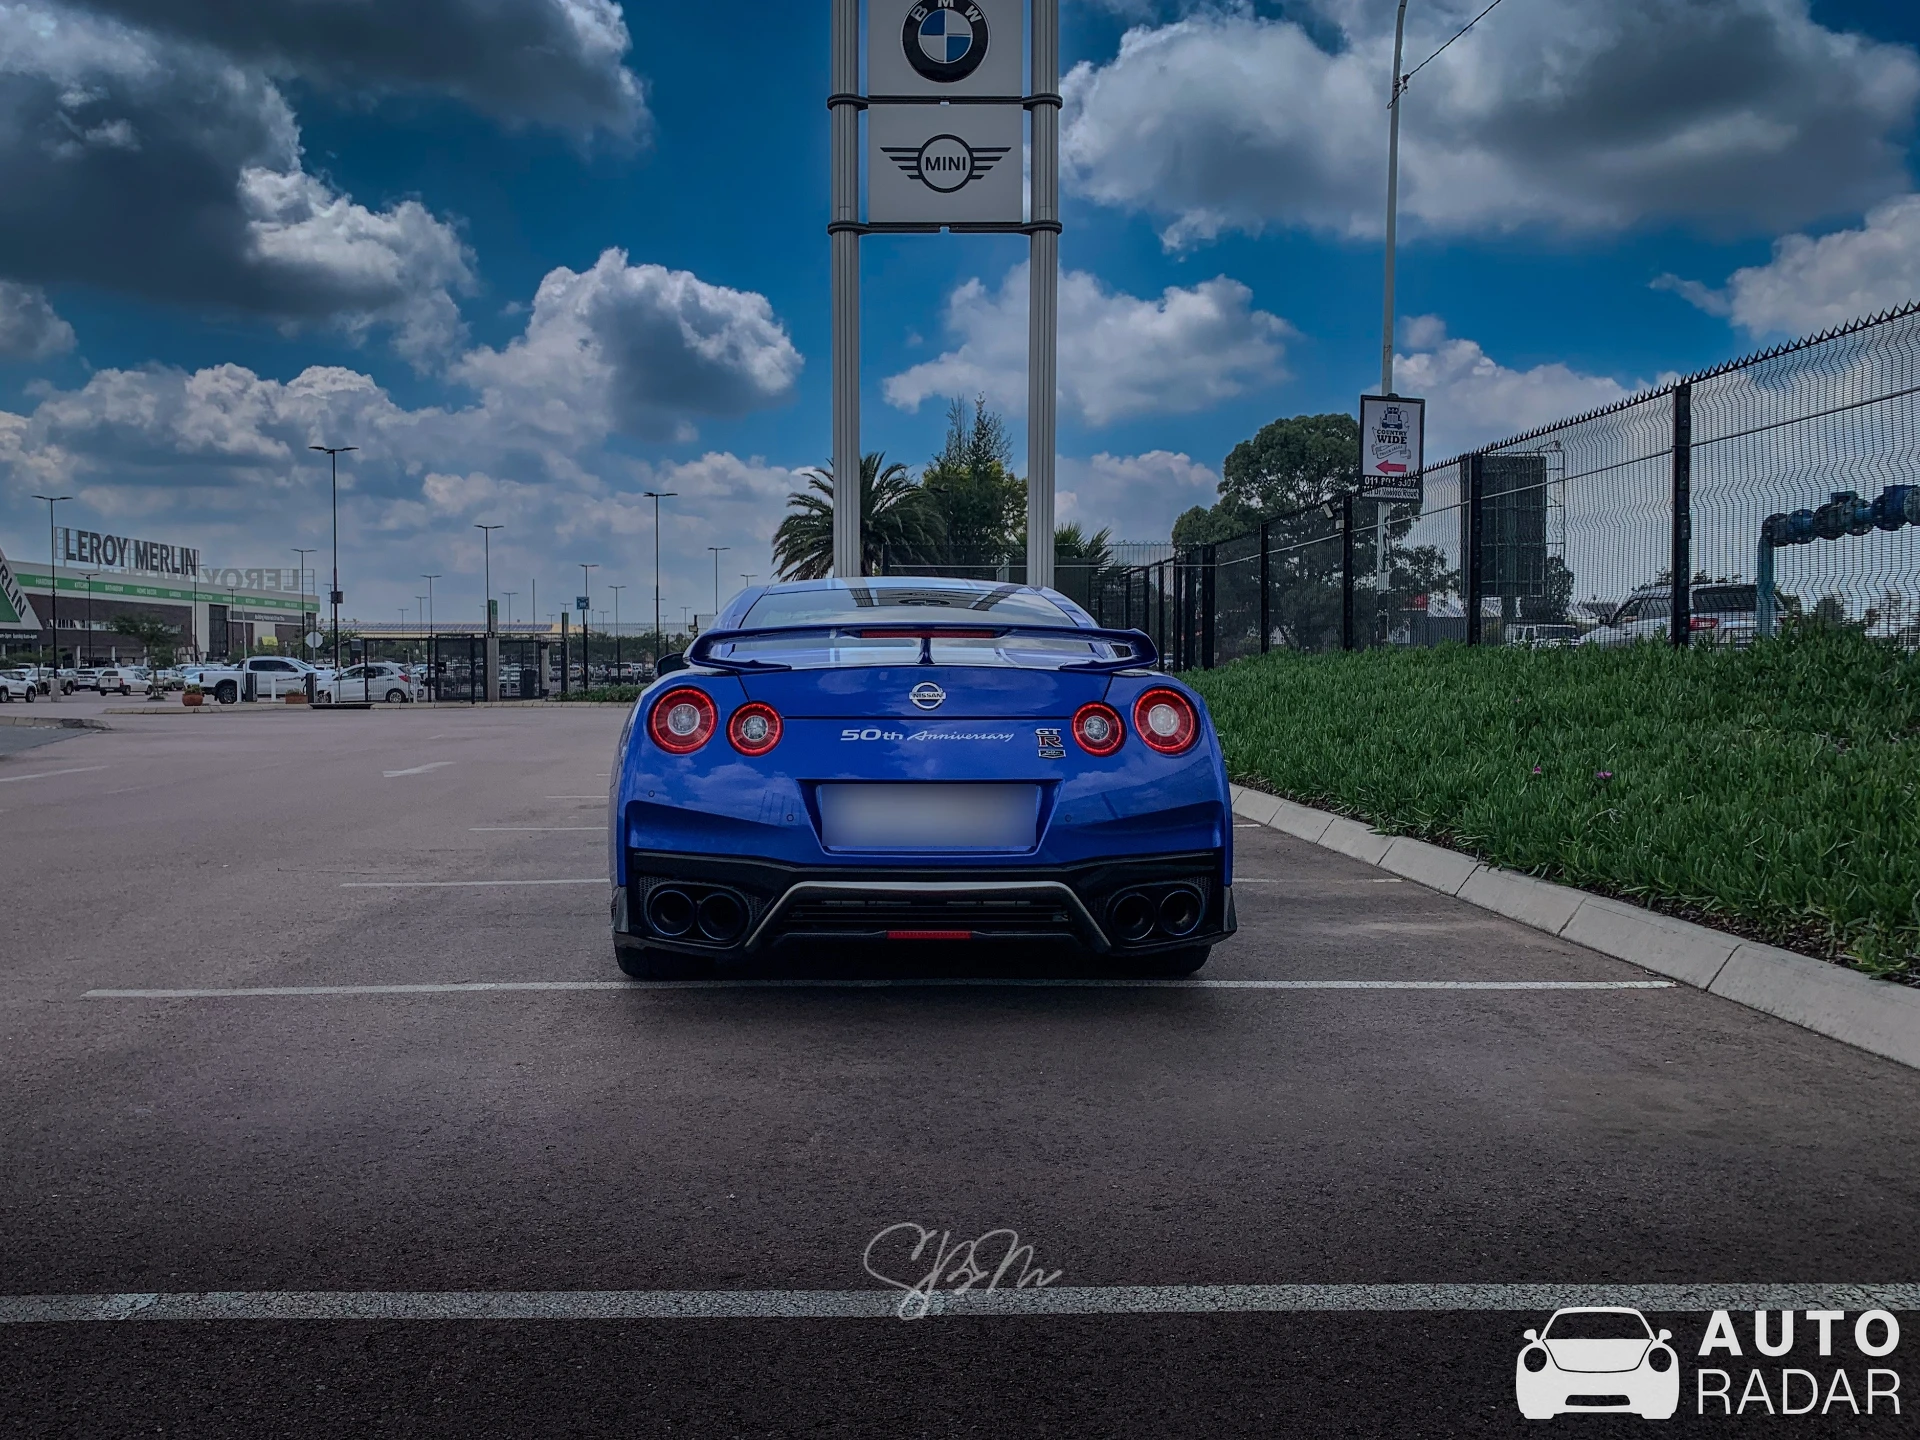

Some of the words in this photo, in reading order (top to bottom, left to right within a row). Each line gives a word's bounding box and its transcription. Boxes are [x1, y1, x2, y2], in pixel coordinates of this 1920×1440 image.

[910, 0, 983, 22] BMW
[925, 156, 966, 171] MINI
[1377, 435, 1407, 444] WIDE
[66, 528, 128, 567] LEROY
[135, 540, 197, 576] MERLIN
[0, 558, 27, 618] RLIN
[840, 728, 904, 741] 50th
[906, 729, 1016, 743] Anniversary
[1037, 734, 1063, 747] R
